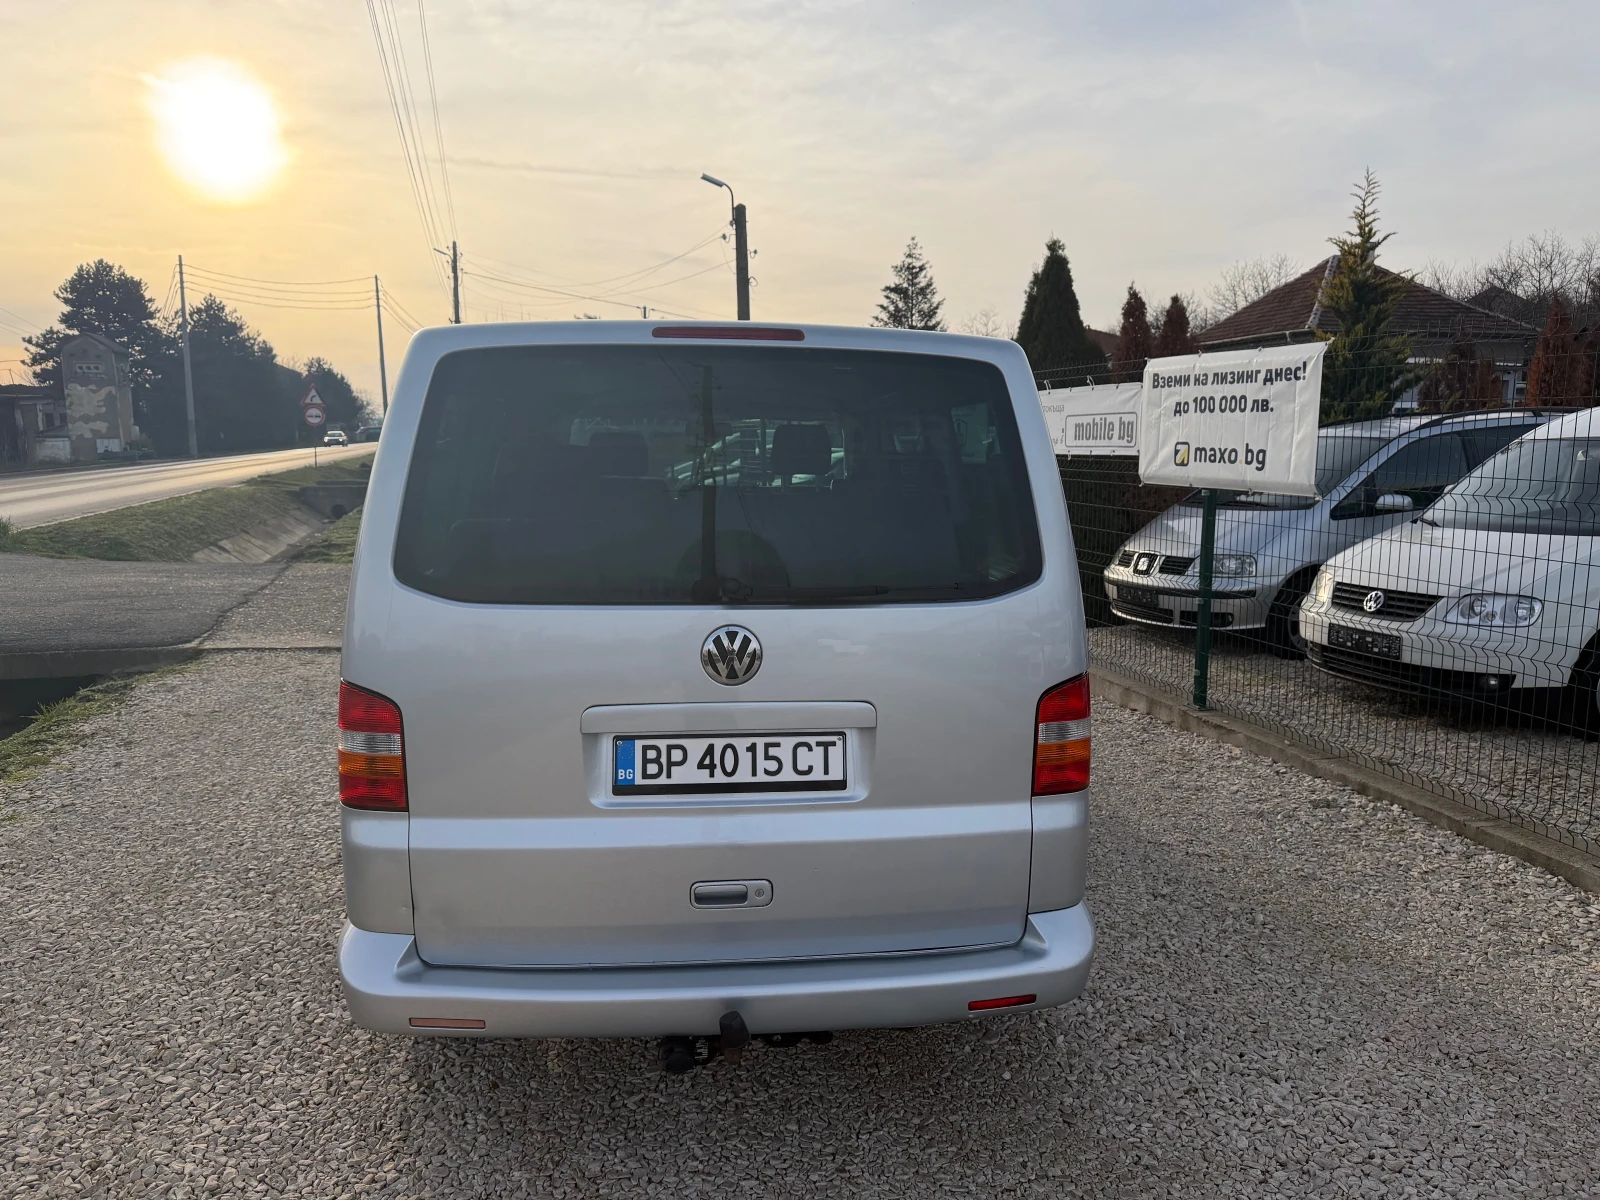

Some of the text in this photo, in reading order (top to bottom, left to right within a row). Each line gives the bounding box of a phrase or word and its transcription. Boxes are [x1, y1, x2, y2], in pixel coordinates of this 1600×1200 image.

[1152, 361, 1307, 389] Вземи на лизинг днес!
[1173, 395, 1274, 417] до 100 000 лв.
[1193, 443, 1267, 471] maxo.bg
[618, 769, 634, 780] BG
[641, 741, 836, 780] BP 4015 CT
